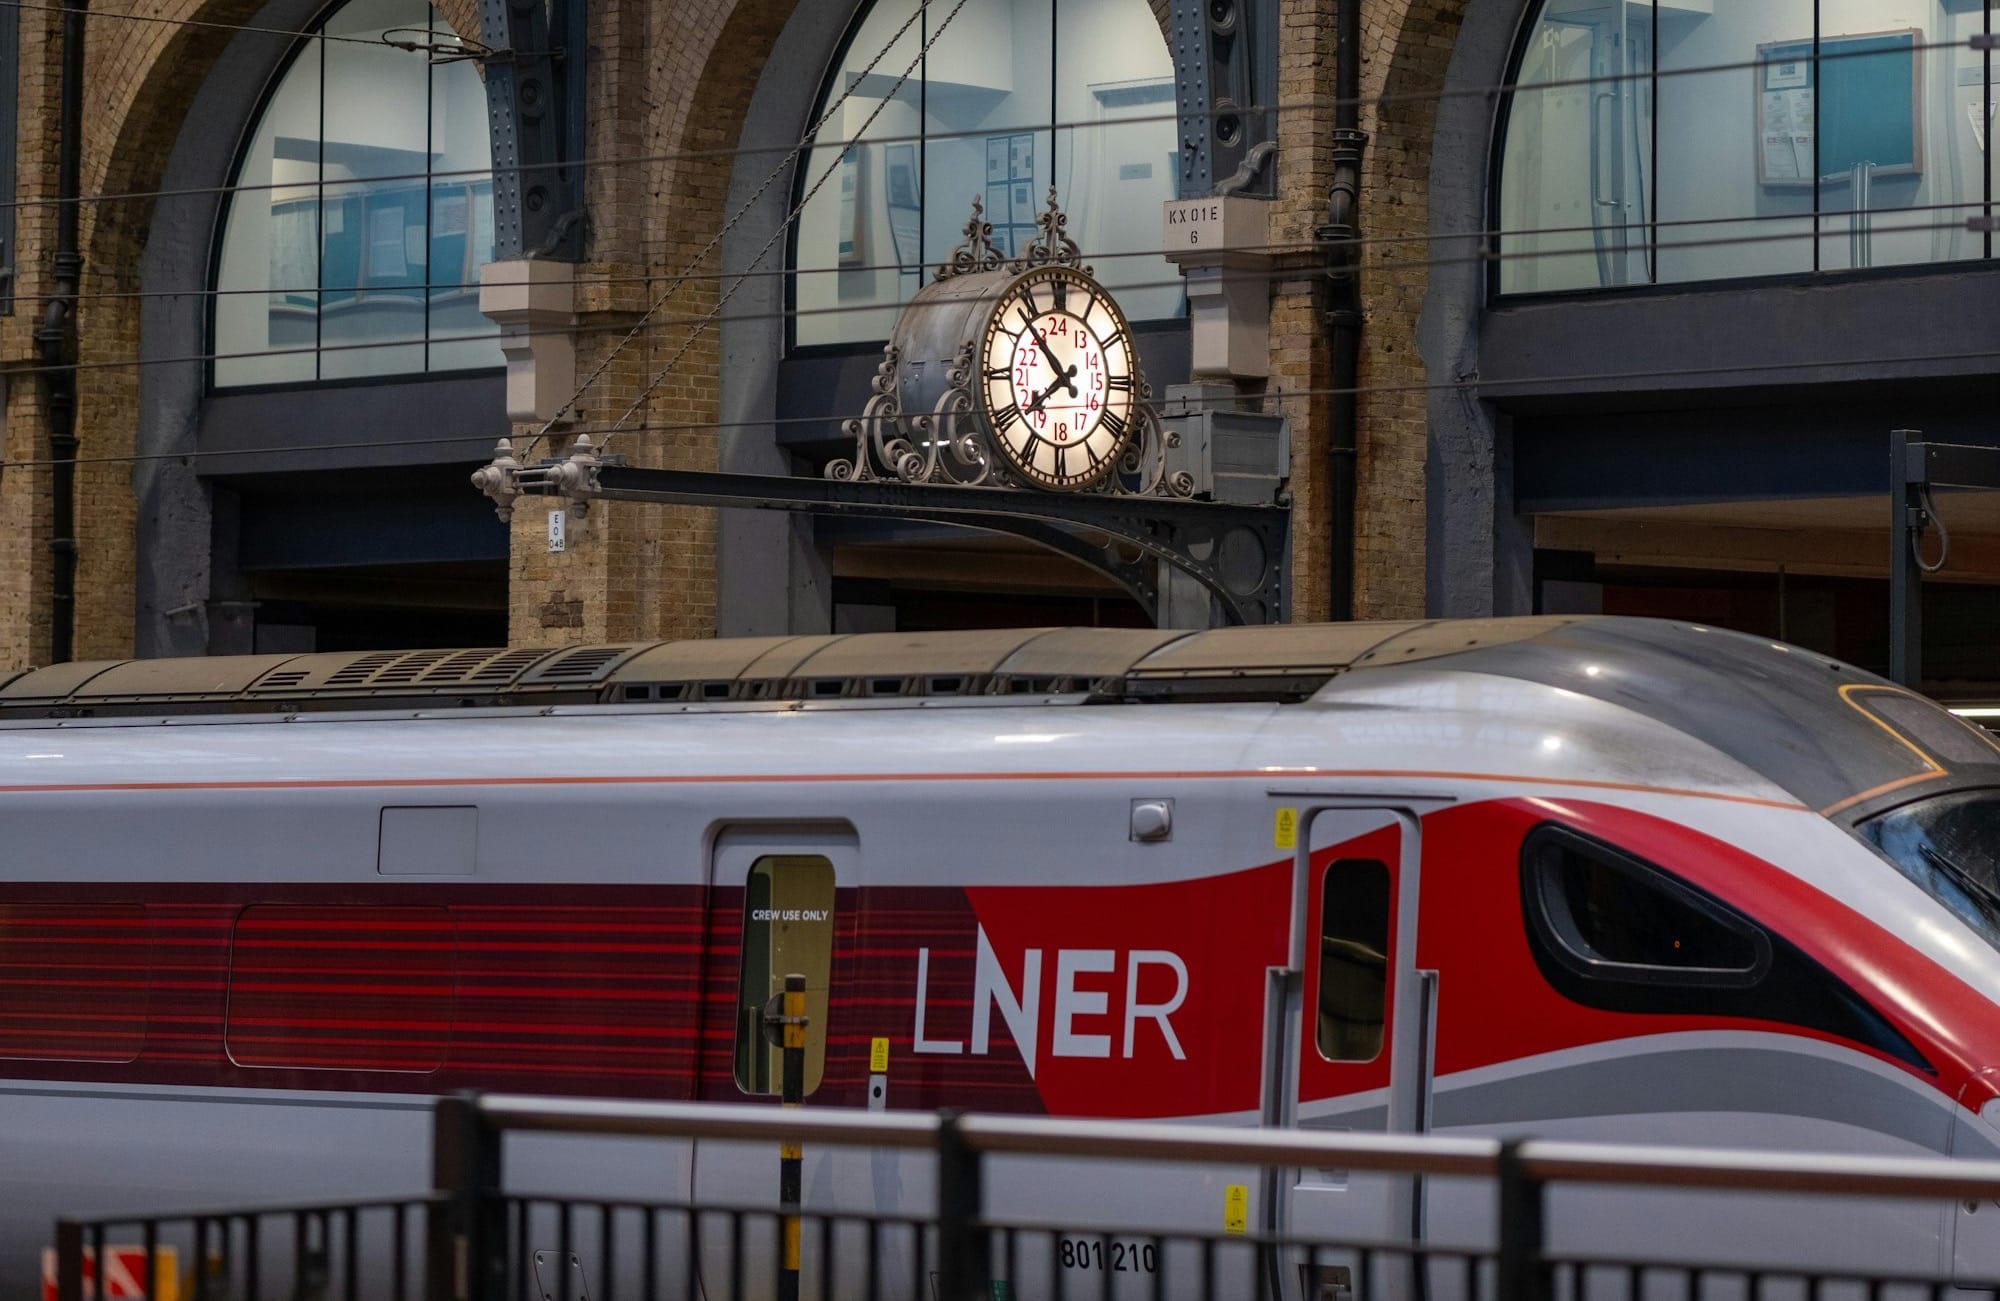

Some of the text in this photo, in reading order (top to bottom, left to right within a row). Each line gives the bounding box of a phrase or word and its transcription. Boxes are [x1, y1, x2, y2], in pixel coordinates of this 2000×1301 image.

[1190, 230, 1198, 244] 6
[1048, 316, 1067, 336] 24
[1074, 329, 1087, 349] 13
[1018, 347, 1038, 367] 22
[1085, 351, 1099, 370] 14
[1015, 367, 1029, 387] 21
[1090, 372, 1103, 391] 15
[1085, 392, 1099, 411] 16
[1033, 409, 1047, 429] 19
[1074, 412, 1087, 431] 17
[1053, 422, 1068, 441] 18
[554, 514, 559, 523] E
[752, 909, 829, 921] CREW USE ONLY
[914, 921, 1189, 1081] LNER
[1061, 1239, 1157, 1273] 801 210
